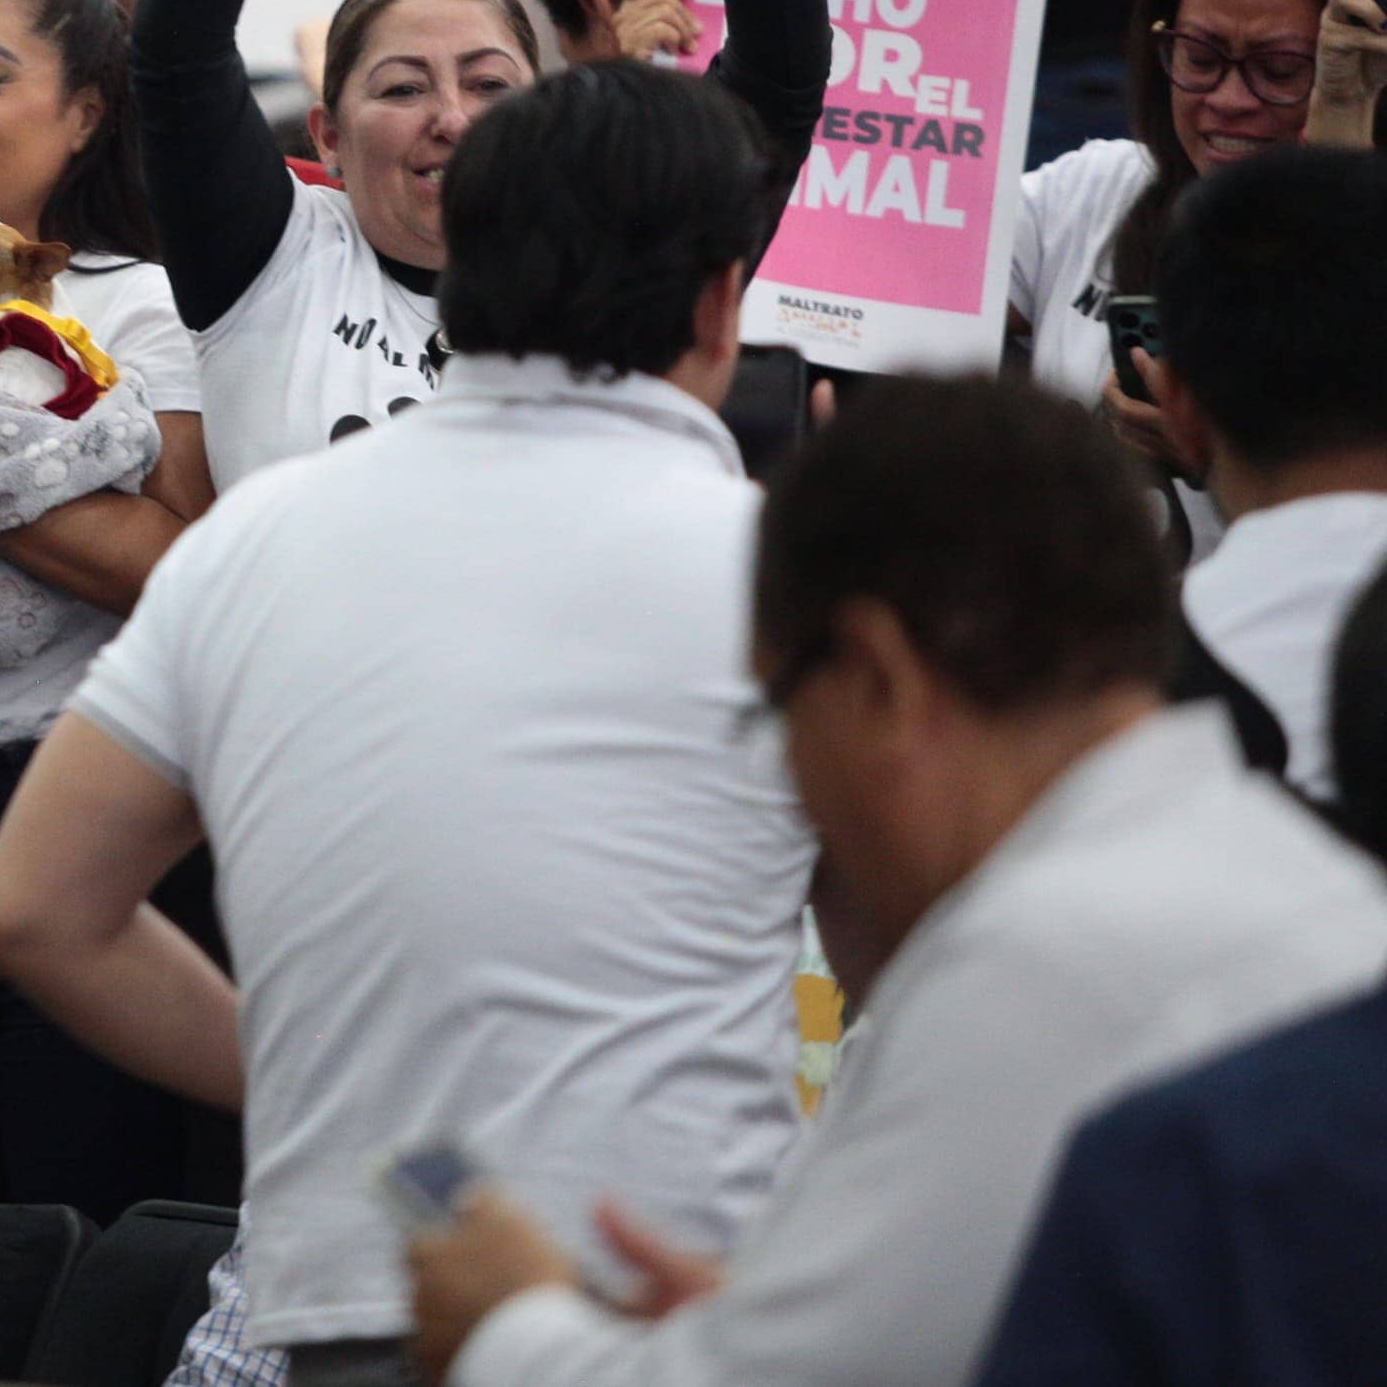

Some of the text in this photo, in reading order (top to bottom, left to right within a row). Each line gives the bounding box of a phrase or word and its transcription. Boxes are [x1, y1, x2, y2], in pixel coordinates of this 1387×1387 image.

[915, 75, 984, 120] EL
[779, 295, 864, 320] MALTRATO
[333, 313, 377, 350] NO
